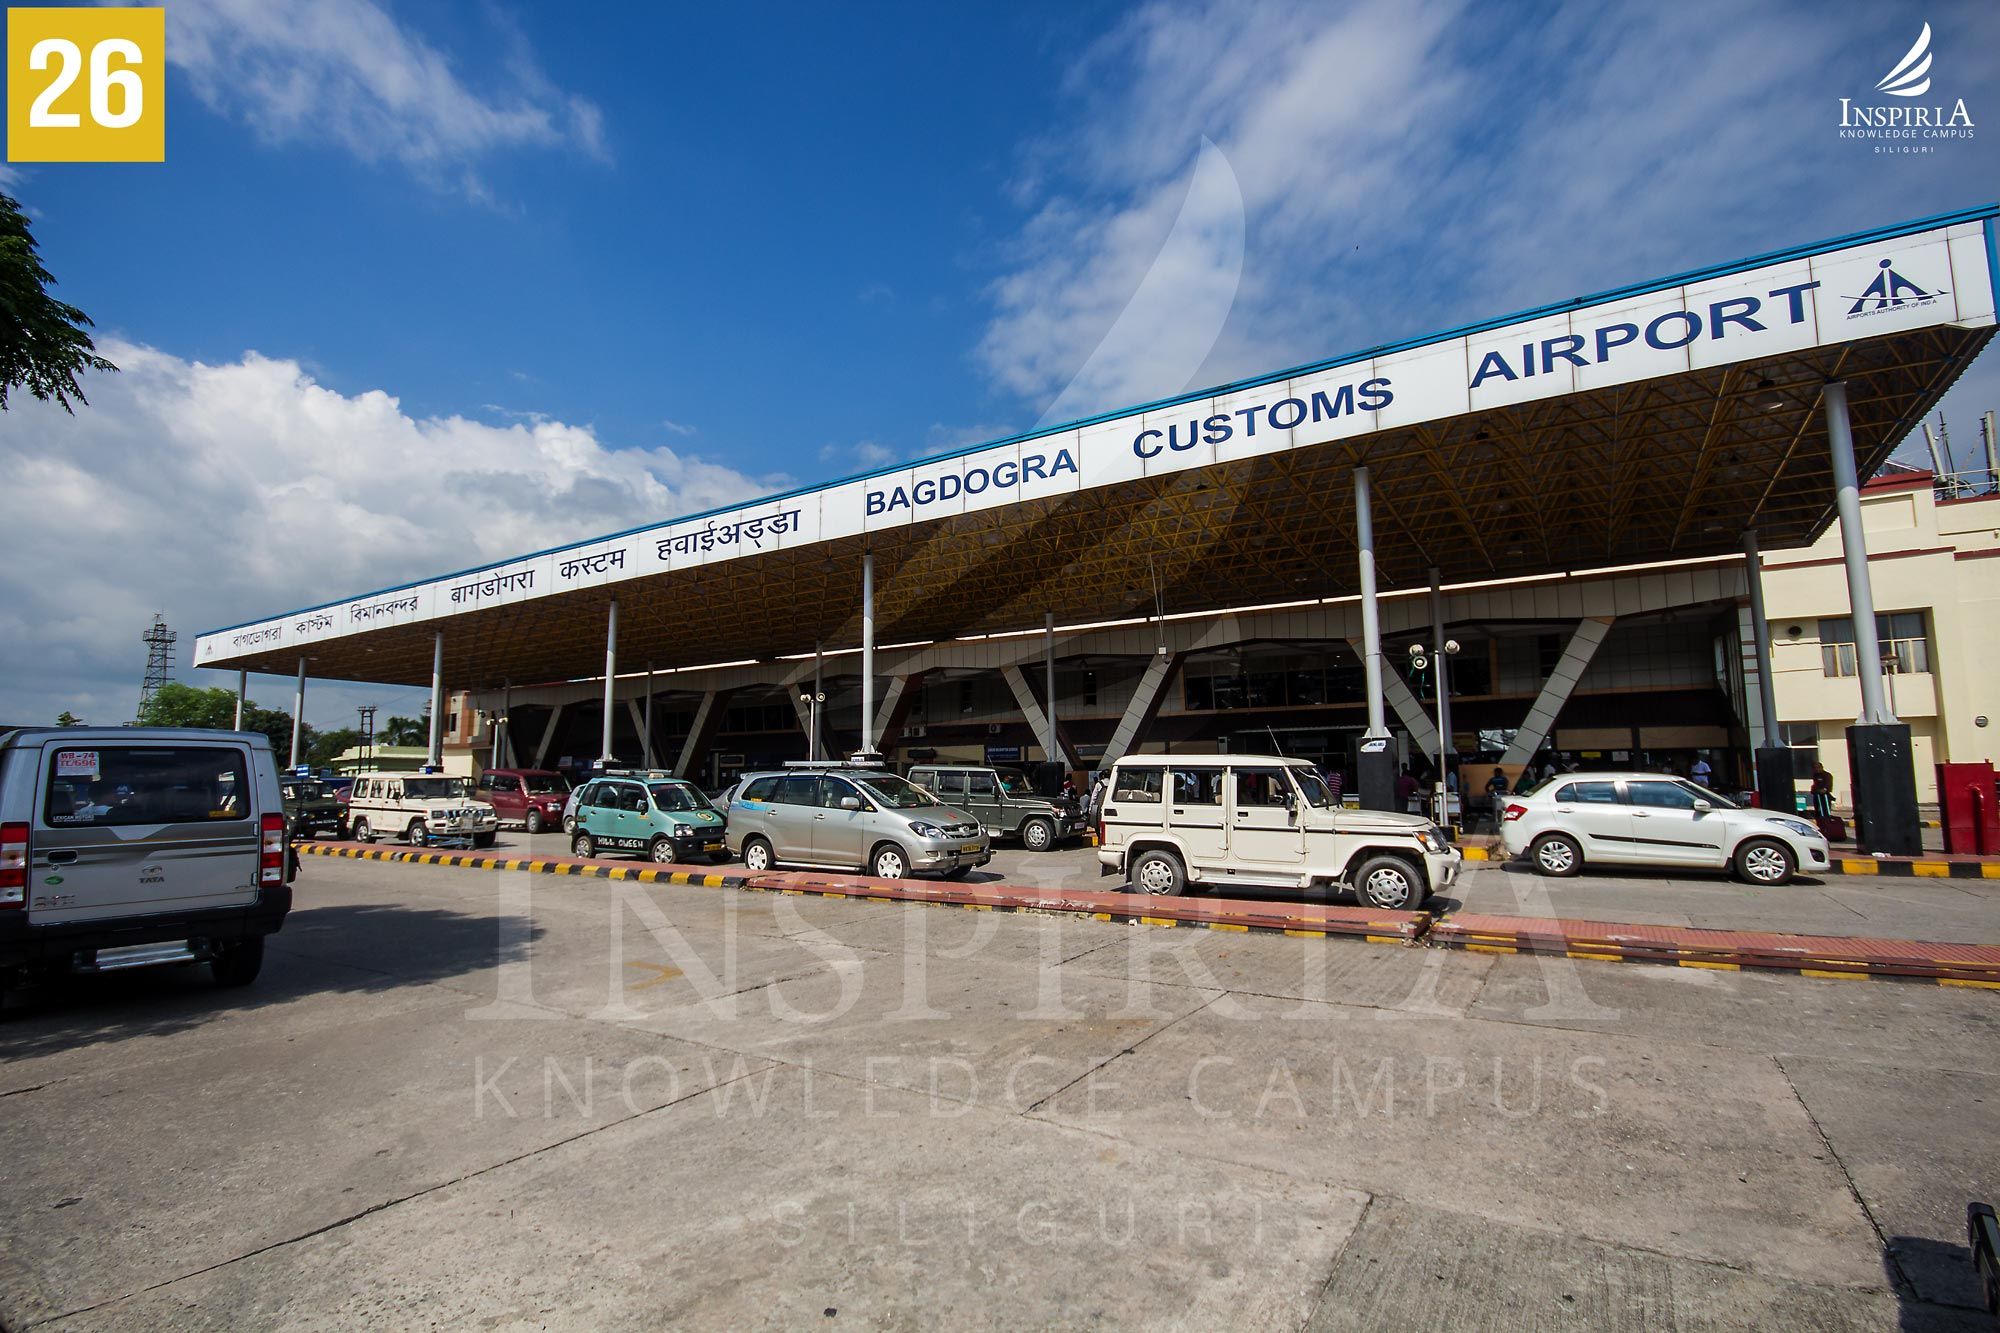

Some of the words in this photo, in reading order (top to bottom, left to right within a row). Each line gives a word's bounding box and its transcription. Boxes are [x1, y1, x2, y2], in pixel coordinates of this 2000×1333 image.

[1846, 309, 1876, 320] AIRPORTS
[1877, 303, 1910, 315] AUTHORITY
[1920, 299, 1937, 307] INDA
[866, 448, 1079, 517] BAGDOGRA
[1133, 377, 1395, 459] CUSTOMS
[1469, 280, 1822, 389] AIRPORT
[451, 569, 536, 603] बागडोगरा
[559, 548, 627, 580] कस्टम
[656, 508, 802, 561] हवाईअड्डा
[232, 625, 282, 649] বাগডোগরা
[296, 614, 333, 635] কাস্টম
[350, 595, 420, 624] বিমানবন্দর
[597, 837, 615, 846] HILL
